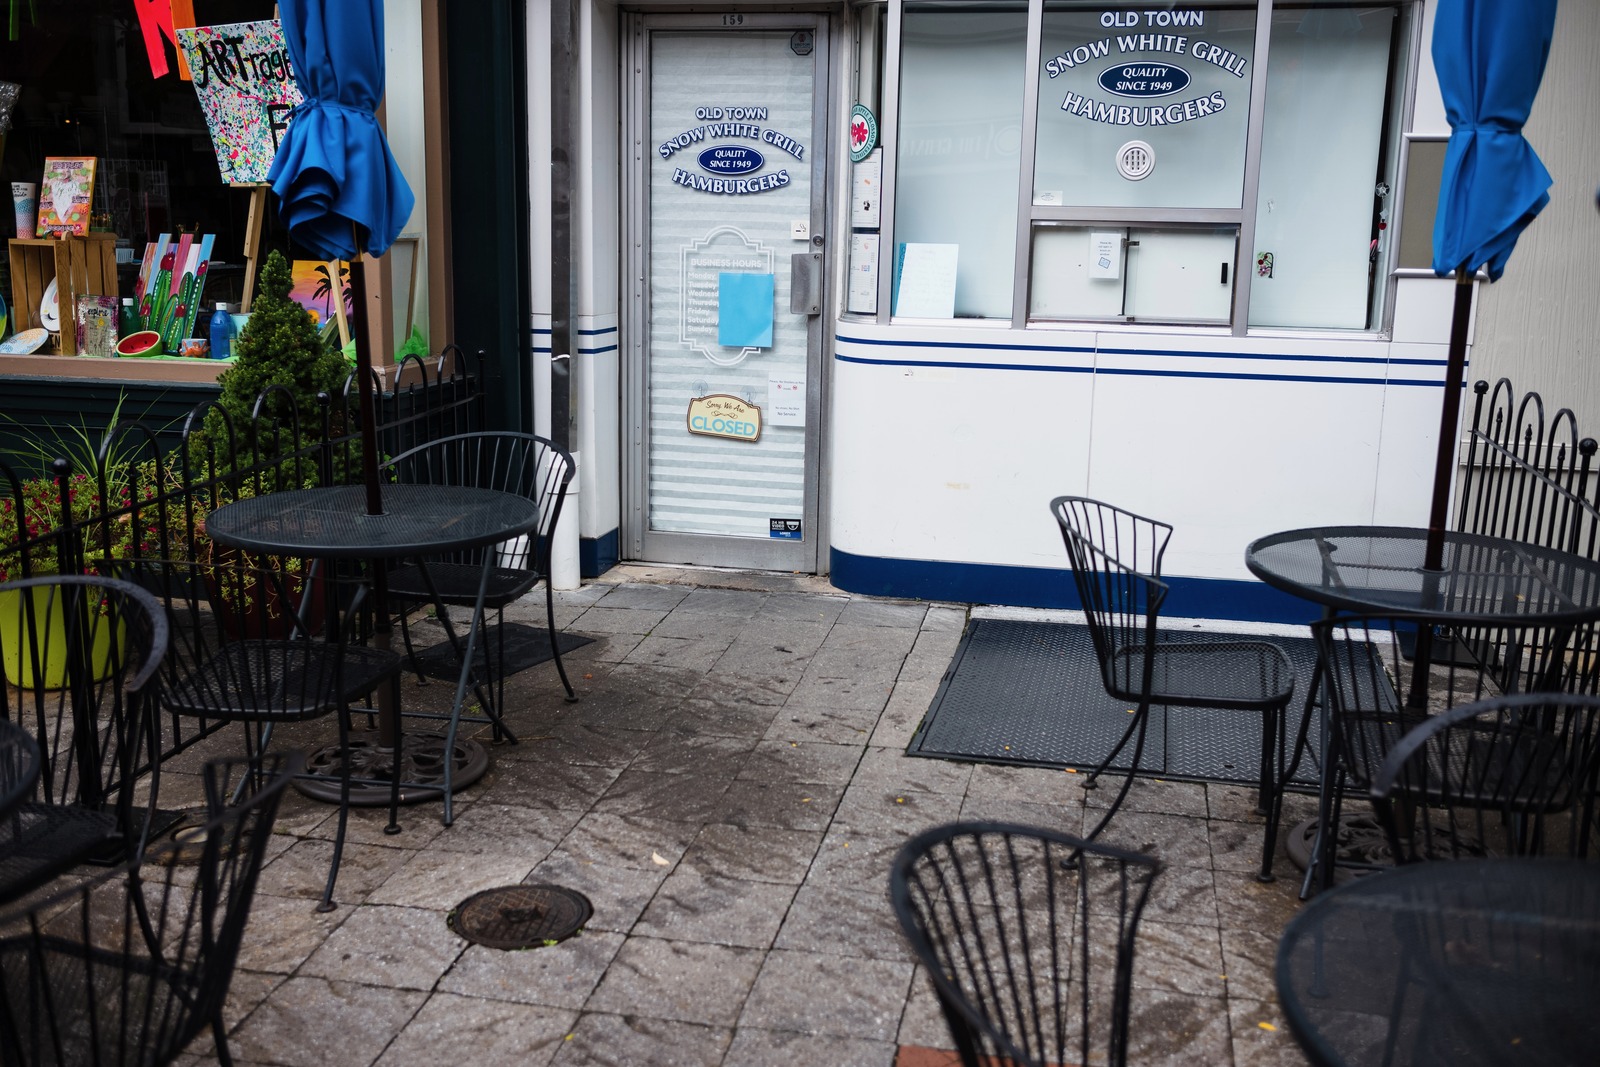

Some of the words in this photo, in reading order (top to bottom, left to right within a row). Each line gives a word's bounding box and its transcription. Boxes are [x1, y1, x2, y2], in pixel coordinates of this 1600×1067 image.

[722, 14, 744, 26] 159
[1100, 11, 1140, 28] OLD
[1143, 10, 1204, 28] TOWN
[1045, 38, 1110, 79] SNOW
[1116, 34, 1189, 55] WHITE
[1191, 41, 1248, 78] GRILL
[1122, 67, 1169, 78] QUALITY
[1115, 81, 1146, 91] SINCE
[1149, 81, 1173, 91] 1949
[695, 107, 723, 120] OLD
[725, 107, 768, 120] TOWN
[1061, 90, 1227, 127] HAMBURGERS
[658, 126, 705, 159] SNOW
[707, 122, 760, 140] WHITE
[761, 128, 805, 161] GRILL
[714, 150, 748, 158] QUALITY
[709, 160, 731, 168] SINCE
[732, 160, 752, 168] 1949
[672, 167, 790, 195] HAMBURGERS
[690, 258, 731, 267] BUSINESS
[732, 259, 762, 268] HOURS
[687, 272, 716, 280] Monday
[687, 281, 717, 290] Tuesday
[687, 307, 710, 315] Friday
[687, 316, 719, 325] Saturday
[724, 401, 733, 410] We
[734, 404, 745, 413] Are
[691, 415, 756, 436] CLOSED
